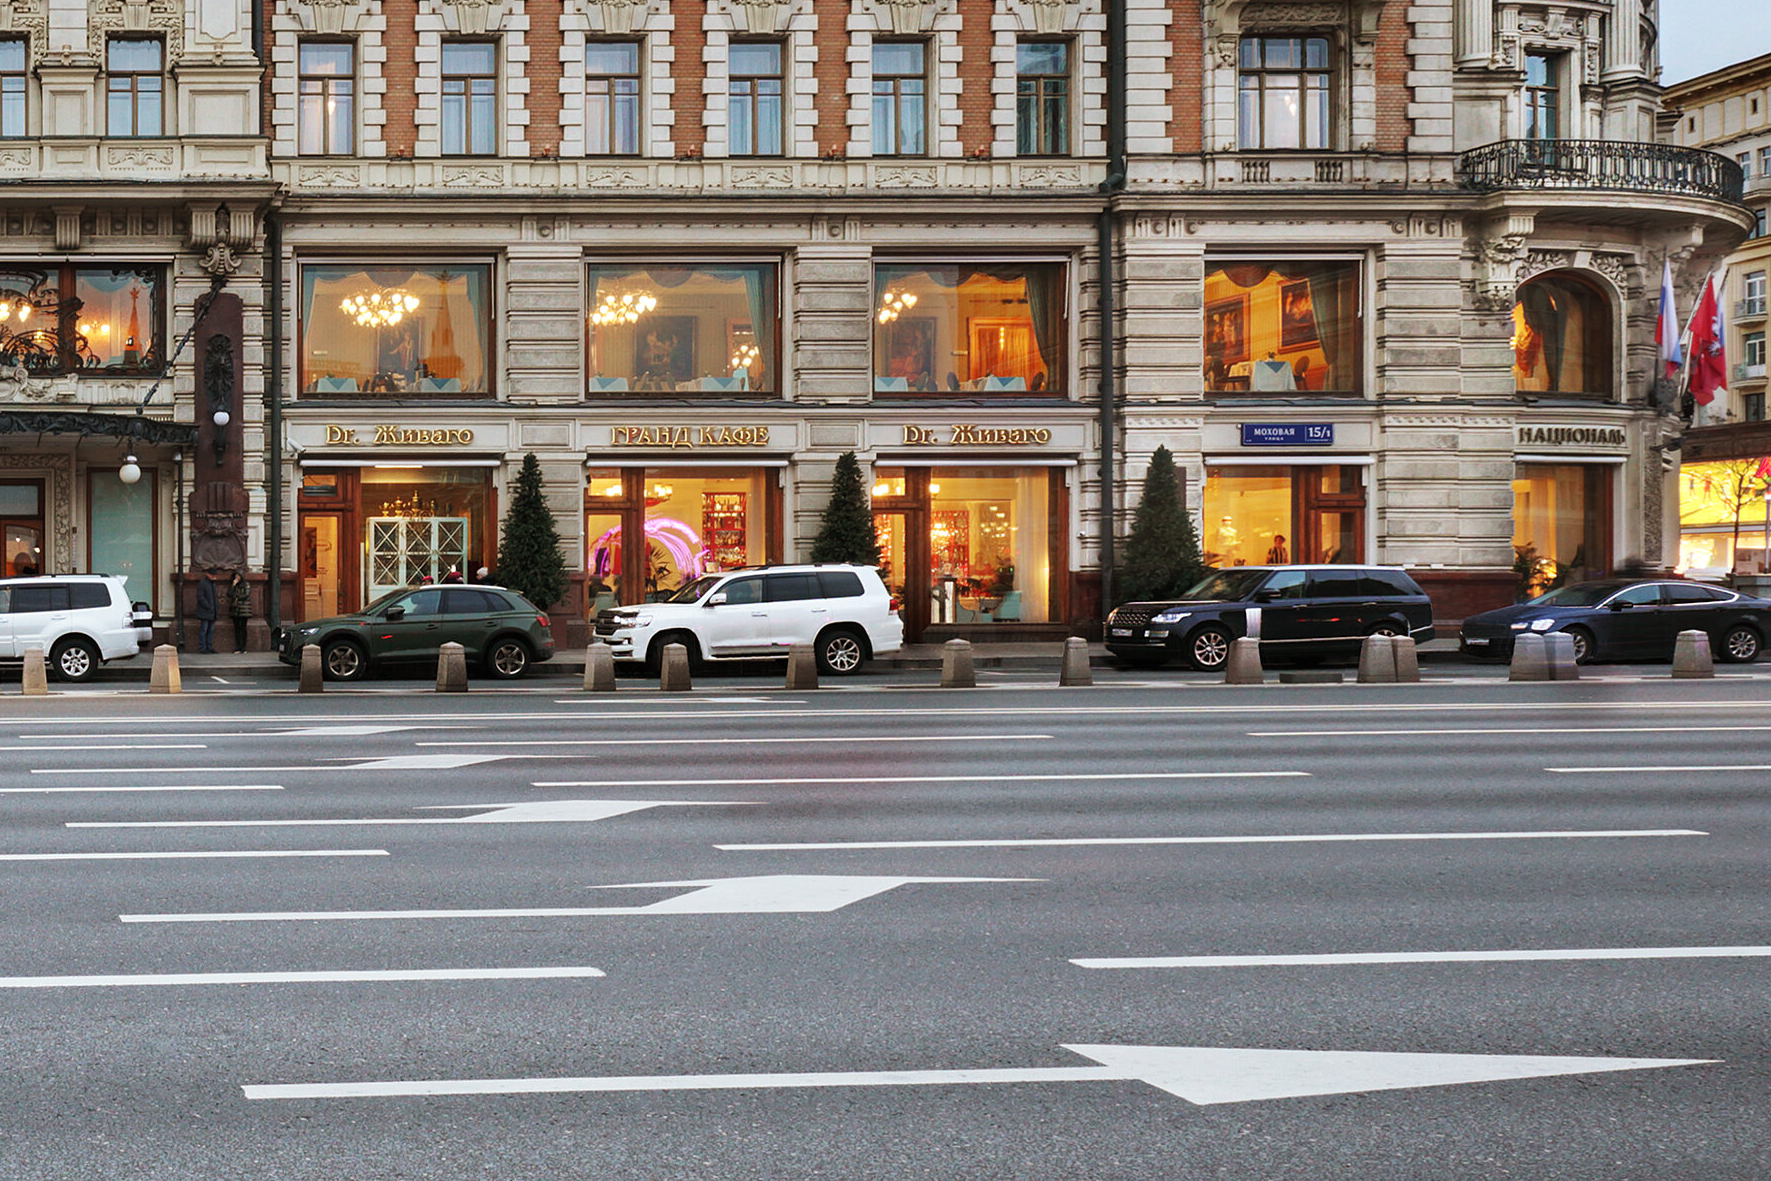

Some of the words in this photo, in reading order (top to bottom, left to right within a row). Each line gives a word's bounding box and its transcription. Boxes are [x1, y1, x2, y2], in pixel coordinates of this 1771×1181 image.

[326, 424, 360, 444] Dr.
[374, 424, 474, 445] Живаго
[611, 426, 693, 449] ГРАНД
[699, 426, 770, 445] КАФЕ
[903, 424, 938, 444] Dr.
[950, 424, 1052, 445] Живаго
[1254, 428, 1295, 436] МОХОВАЯ
[1308, 427, 1331, 438] 15/1
[1519, 427, 1625, 445] НАЦИОНАЛЬ
